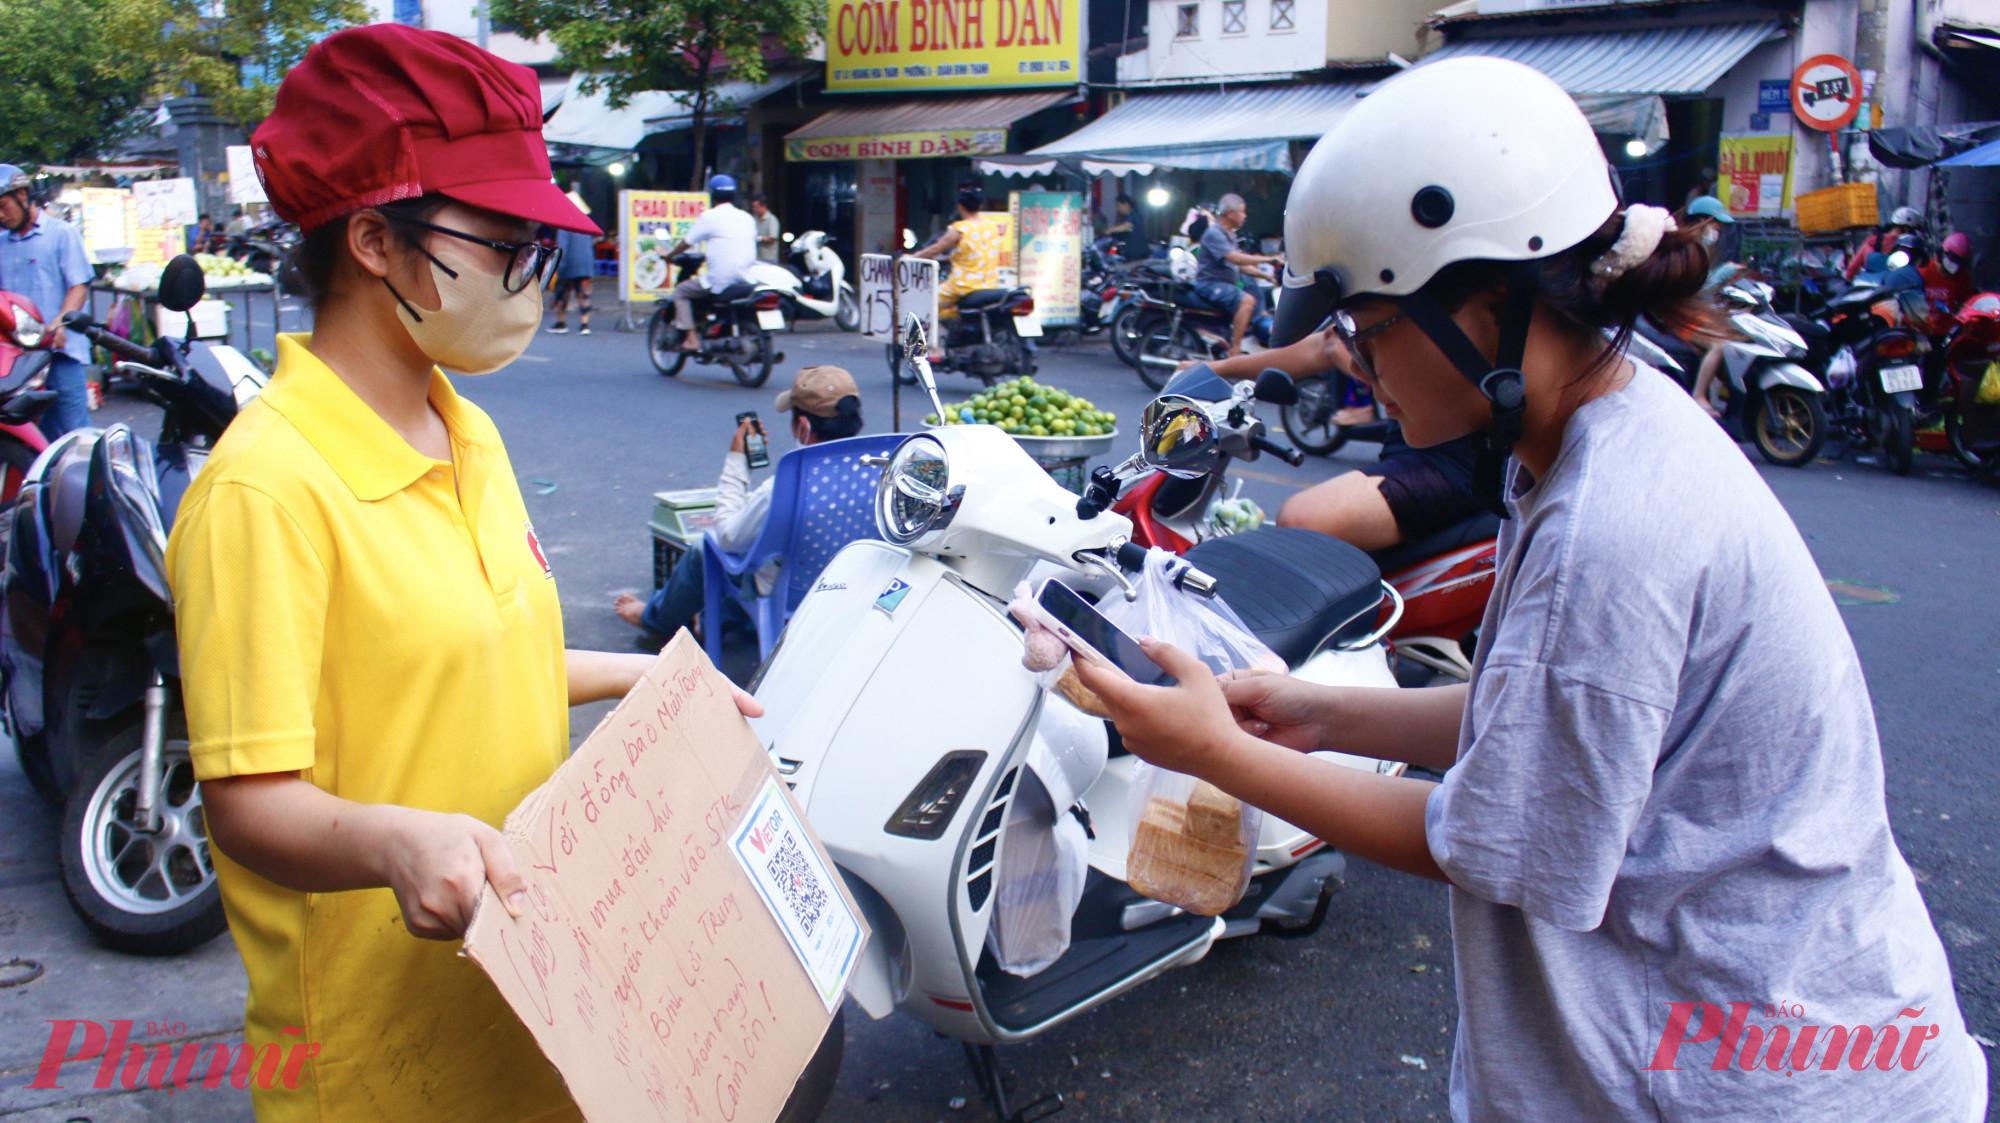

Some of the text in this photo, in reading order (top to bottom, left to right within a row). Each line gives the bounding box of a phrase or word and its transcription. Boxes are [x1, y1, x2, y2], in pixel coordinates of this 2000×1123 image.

[807, 141, 853, 158] CƠM
[857, 138, 912, 156] BÌNH
[919, 134, 971, 154] DÂN
[579, 758, 637, 823] đồng
[621, 719, 658, 767] bào
[590, 878, 626, 930] mua
[622, 833, 653, 877] đậu
[650, 984, 684, 1048] Bình
[716, 1054, 748, 1122] Cảm
